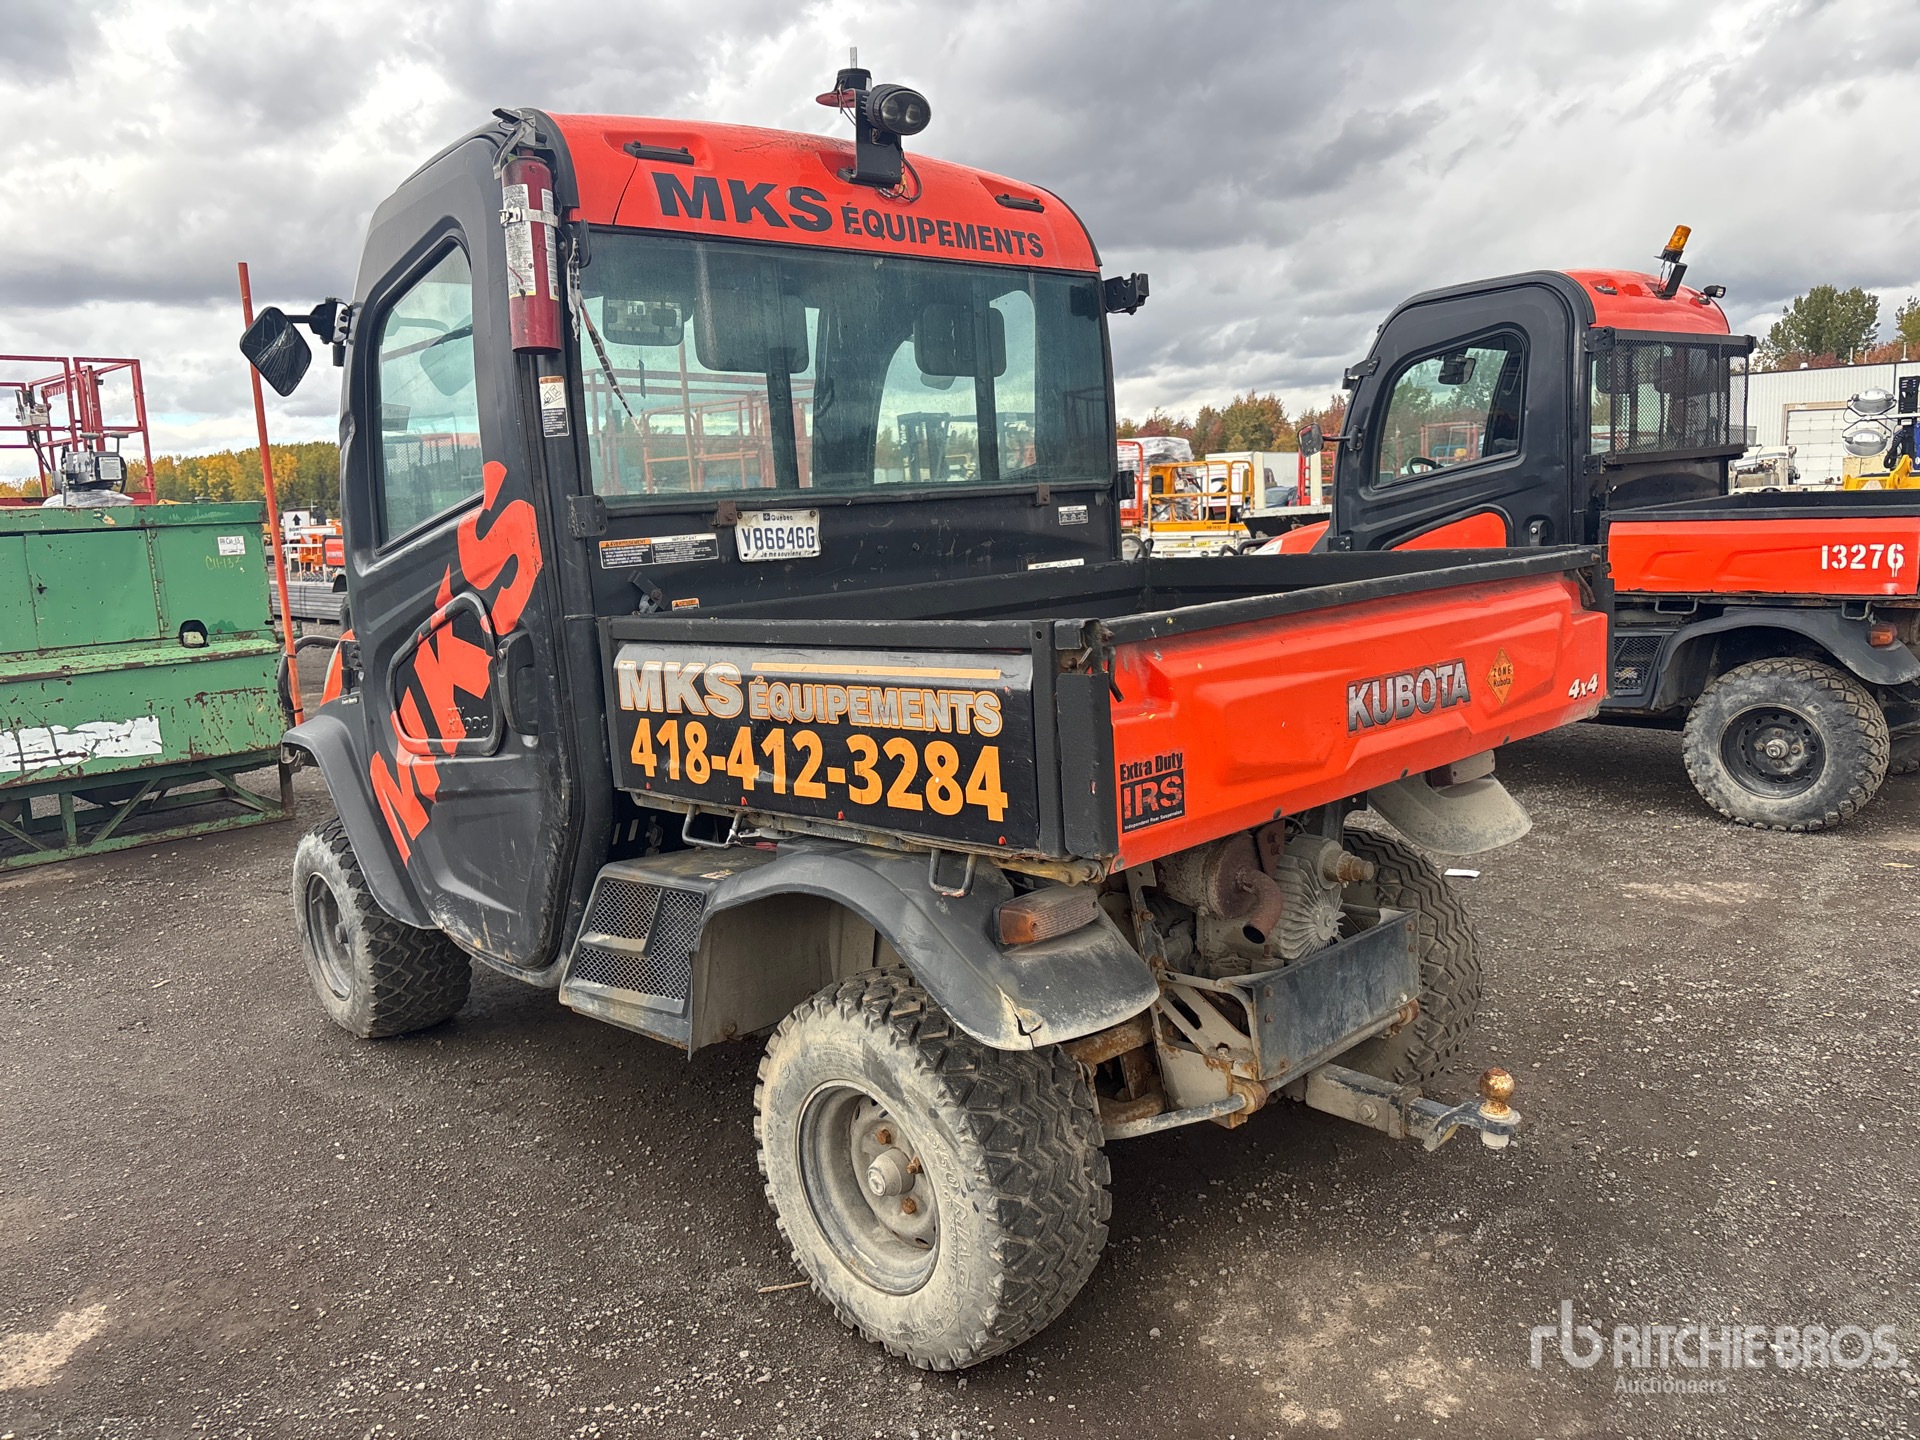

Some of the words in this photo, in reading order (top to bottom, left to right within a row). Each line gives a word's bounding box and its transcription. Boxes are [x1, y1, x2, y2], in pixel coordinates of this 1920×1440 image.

[650, 171, 833, 232] MKS
[842, 202, 1045, 259] ÉQUIPEMENTS
[771, 513, 793, 521] Québec
[1821, 543, 1905, 571] 13276
[370, 460, 543, 868] MKS
[1493, 664, 1512, 677] ZONE
[1347, 661, 1471, 732] KUBOTA
[1493, 677, 1512, 687] Kubota
[1568, 674, 1599, 699] 4x4
[617, 660, 744, 719] MKS
[748, 675, 1003, 737] ÉQUIPEMENTS
[630, 718, 1009, 822] 418-412-3284
[1120, 760, 1152, 782] Extra
[1155, 752, 1183, 773] Duty
[1123, 775, 1183, 819] IRS
[1124, 819, 1150, 830] Independent
[1150, 814, 1160, 822] Rear
[1160, 809, 1182, 819] Suspension
